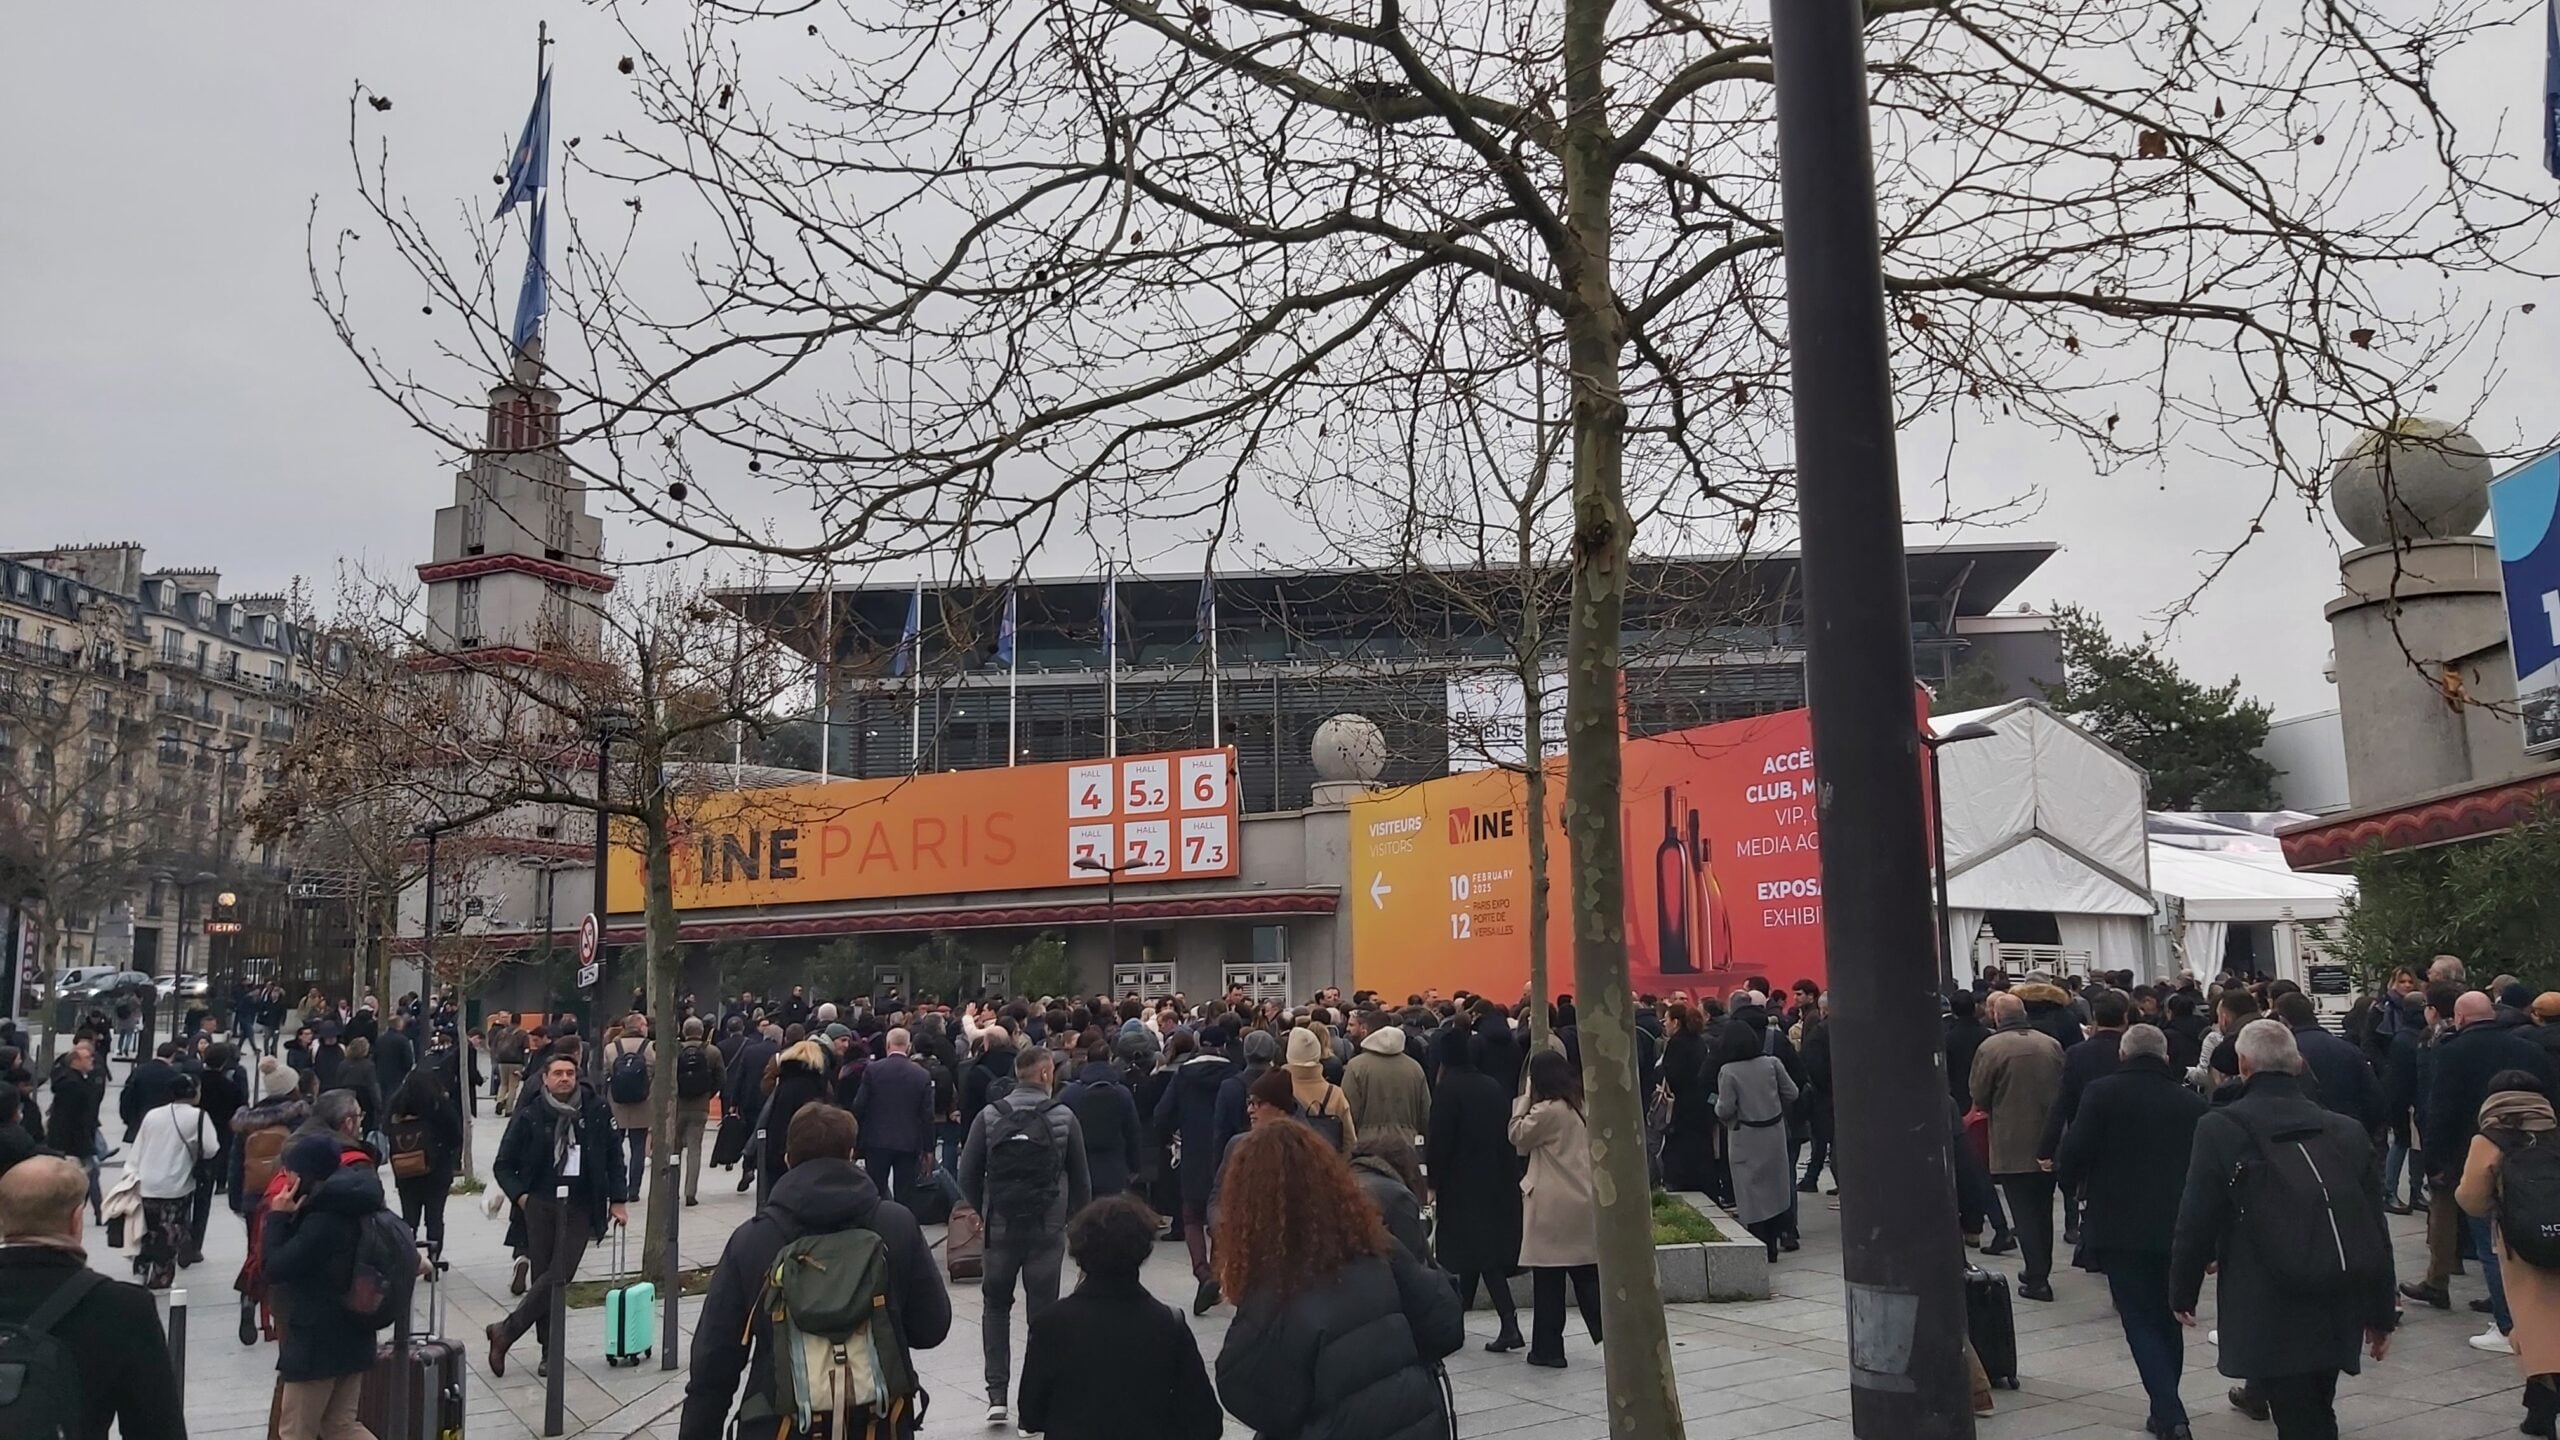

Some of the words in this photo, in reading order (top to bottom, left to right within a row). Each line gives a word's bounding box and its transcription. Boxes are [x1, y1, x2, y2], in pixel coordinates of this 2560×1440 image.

[1456, 711, 1477, 724] BE
[1457, 723, 1523, 738] SRITS
[1136, 765, 1157, 773] HALL
[1192, 760, 1213, 768] HALL
[1081, 770, 1101, 778] HALL
[1081, 784, 1102, 810] 4
[1129, 779, 1164, 807] 5.2
[1194, 774, 1214, 801] 6
[1746, 780, 1797, 803] CLUB,
[1802, 778, 1817, 797] M
[1193, 822, 1215, 830] HALL
[1449, 807, 1513, 845] WINE
[1775, 806, 1807, 827] VIP,
[1081, 830, 1101, 838] HALL
[1136, 826, 1158, 834] HALL
[1369, 816, 1422, 838] VISITEURS
[820, 811, 1018, 878] PARIS
[1129, 840, 1165, 867] 7.2
[1186, 836, 1223, 864] 7.3
[1369, 838, 1414, 857] VISITORS
[1736, 837, 1792, 858] MEDIA
[1795, 830, 1819, 852] AC
[1076, 844, 1106, 871] 71
[1472, 869, 1514, 883] FEBRUARY
[1450, 875, 1469, 901] 10
[1473, 883, 1492, 894] 2025
[1473, 900, 1491, 910] PARIS
[1492, 898, 1510, 909] EXPO
[1450, 913, 1471, 939] 12
[1473, 912, 1494, 924] PORTE
[1496, 911, 1506, 922] DE
[207, 923, 242, 932] METRO
[1474, 924, 1514, 938] VERSAILLES
